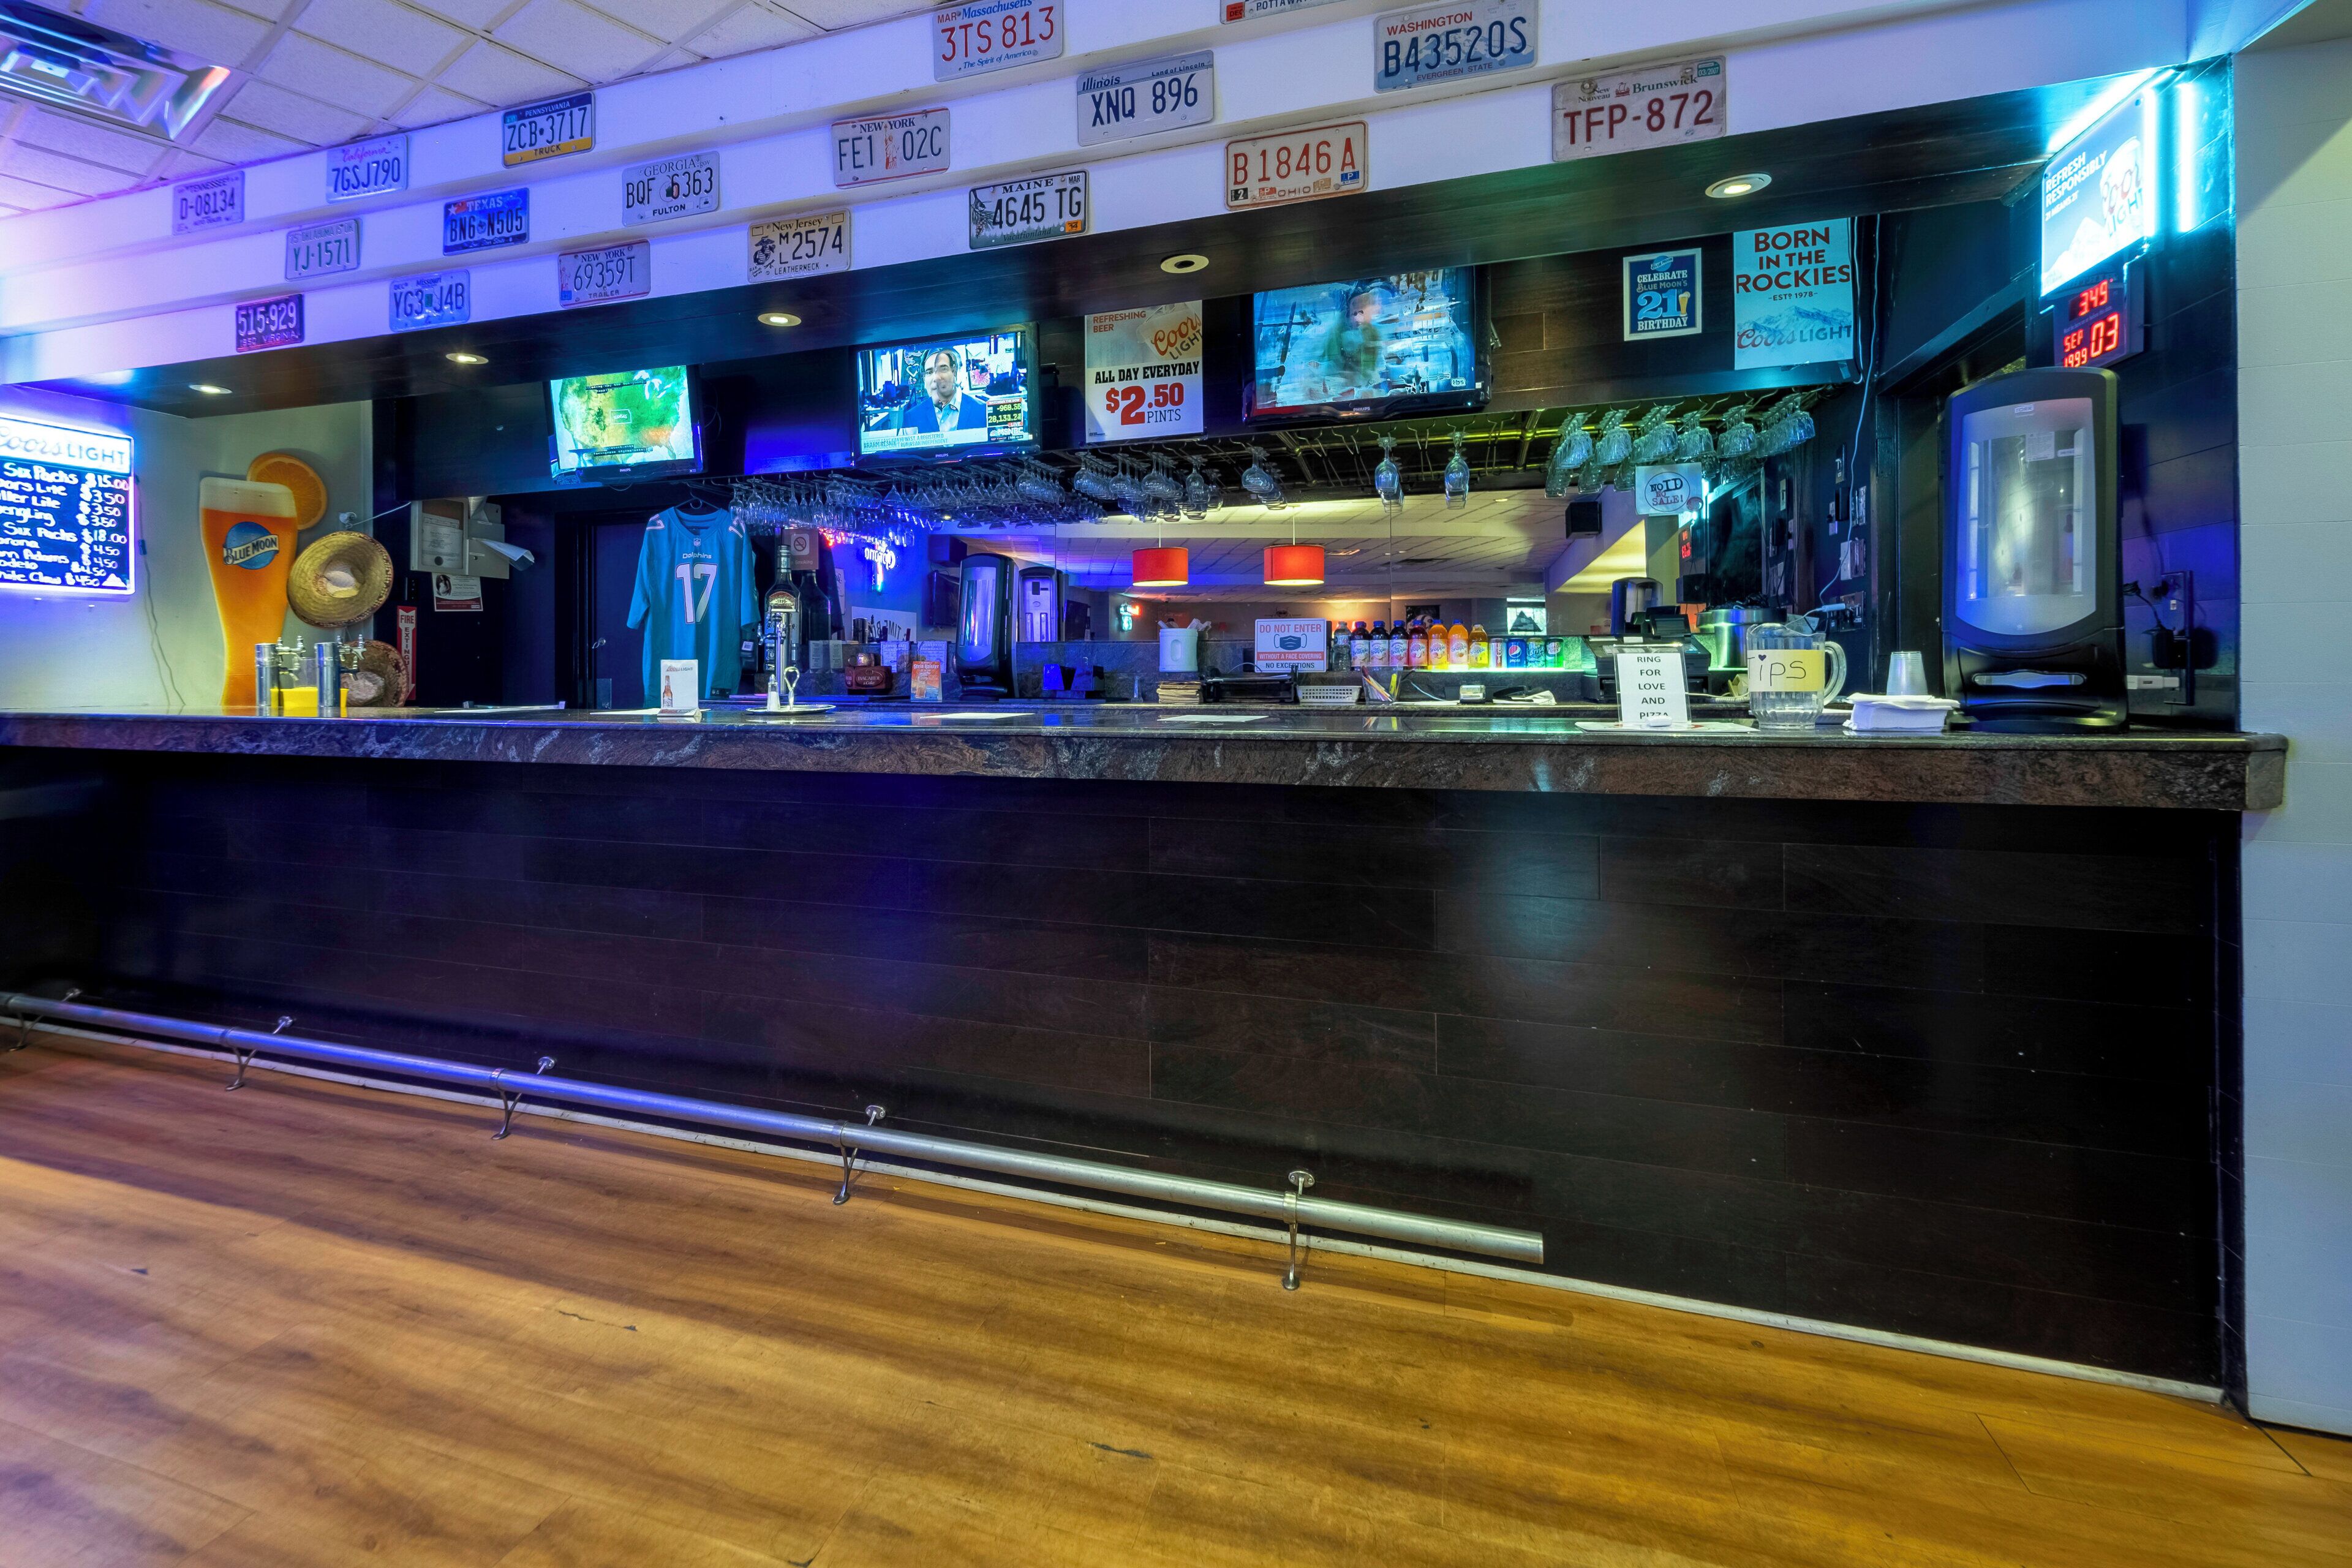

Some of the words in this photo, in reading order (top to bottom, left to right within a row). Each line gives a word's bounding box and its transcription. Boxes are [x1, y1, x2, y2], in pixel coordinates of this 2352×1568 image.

[937, 12, 957, 24] MAR
[1387, 11, 1472, 36] WASHINGTON
[941, 19, 991, 61] 3TS
[1002, 6, 1054, 48] 813
[1384, 16, 1527, 78] B43520S
[977, 56, 994, 67] Spirit
[996, 55, 1003, 64] of
[1004, 50, 1032, 61] America
[1179, 61, 1205, 72] Lincoln
[1417, 67, 1463, 81] EVERGREEN
[1468, 62, 1493, 72] STATE
[1081, 75, 1121, 91] Illinois
[1632, 75, 1698, 94] Brunswick
[1091, 86, 1136, 128] XNQ
[1152, 73, 1198, 115] 896
[1578, 93, 1611, 103] Nouveau
[525, 100, 570, 117] PENNSYLVANIA
[859, 122, 884, 134] NEW
[887, 117, 916, 130] YORK
[1563, 90, 1714, 145] TFP-872
[342, 146, 391, 164] California
[534, 145, 562, 156] TRUCK
[331, 157, 401, 194] 7GSJ790
[1068, 175, 1081, 184] MAR
[2045, 151, 2086, 194] REFRESH
[2045, 150, 2108, 208] RESPONSIBLY
[671, 167, 714, 200] 6363
[1001, 178, 1054, 194] MAINE
[1278, 186, 1311, 197] OHIO
[179, 187, 235, 221] D-08134
[467, 196, 504, 213] TEXAS
[652, 204, 686, 216] FULTON
[992, 190, 1045, 230] 4645
[1055, 186, 1082, 219] TG
[772, 222, 793, 233] New
[795, 217, 823, 232] Jersey
[1003, 226, 1052, 243] Vacationland
[1754, 227, 1830, 252] BORN
[792, 225, 843, 262] 2574
[581, 252, 601, 263] NEW
[605, 248, 626, 260] YORK
[1759, 255, 1782, 270] IN
[1785, 249, 1826, 267] THE
[573, 256, 635, 292] 69359T
[774, 262, 820, 276] LEATHERNECK
[1637, 270, 1687, 283] CELEBRATE
[1736, 265, 1850, 293] ROCKIES
[588, 289, 620, 300] TRAILER
[1637, 288, 1681, 320] 21
[1093, 311, 1147, 323] REFRESHING
[1637, 317, 1688, 331] BIRTHDAY
[1093, 324, 1114, 333] BEER
[1151, 313, 1202, 356] Coors
[1737, 328, 1795, 349] Coors
[1800, 325, 1852, 341] LIGHT
[2090, 312, 2120, 358] 03
[2064, 328, 2084, 353] SEP
[1095, 370, 1115, 384] ALL
[1118, 367, 1139, 382] DAY
[1143, 361, 1200, 379] EVERYDAY
[1106, 382, 1184, 426] $2.50
[1147, 409, 1181, 423] PINTS
[998, 427, 1023, 435] MSNBC
[67, 443, 126, 465] LIGHT
[1650, 482, 1664, 492] NO
[1664, 478, 1684, 492] ID
[1652, 494, 1684, 506] SALE!
[675, 562, 718, 625] 17
[400, 614, 414, 624] FIRE
[1274, 624, 1291, 633] NOT
[1294, 624, 1322, 633] ENTER
[1640, 668, 1662, 677] FOR
[1638, 682, 1666, 691] LOVE
[1641, 696, 1665, 705] AND
